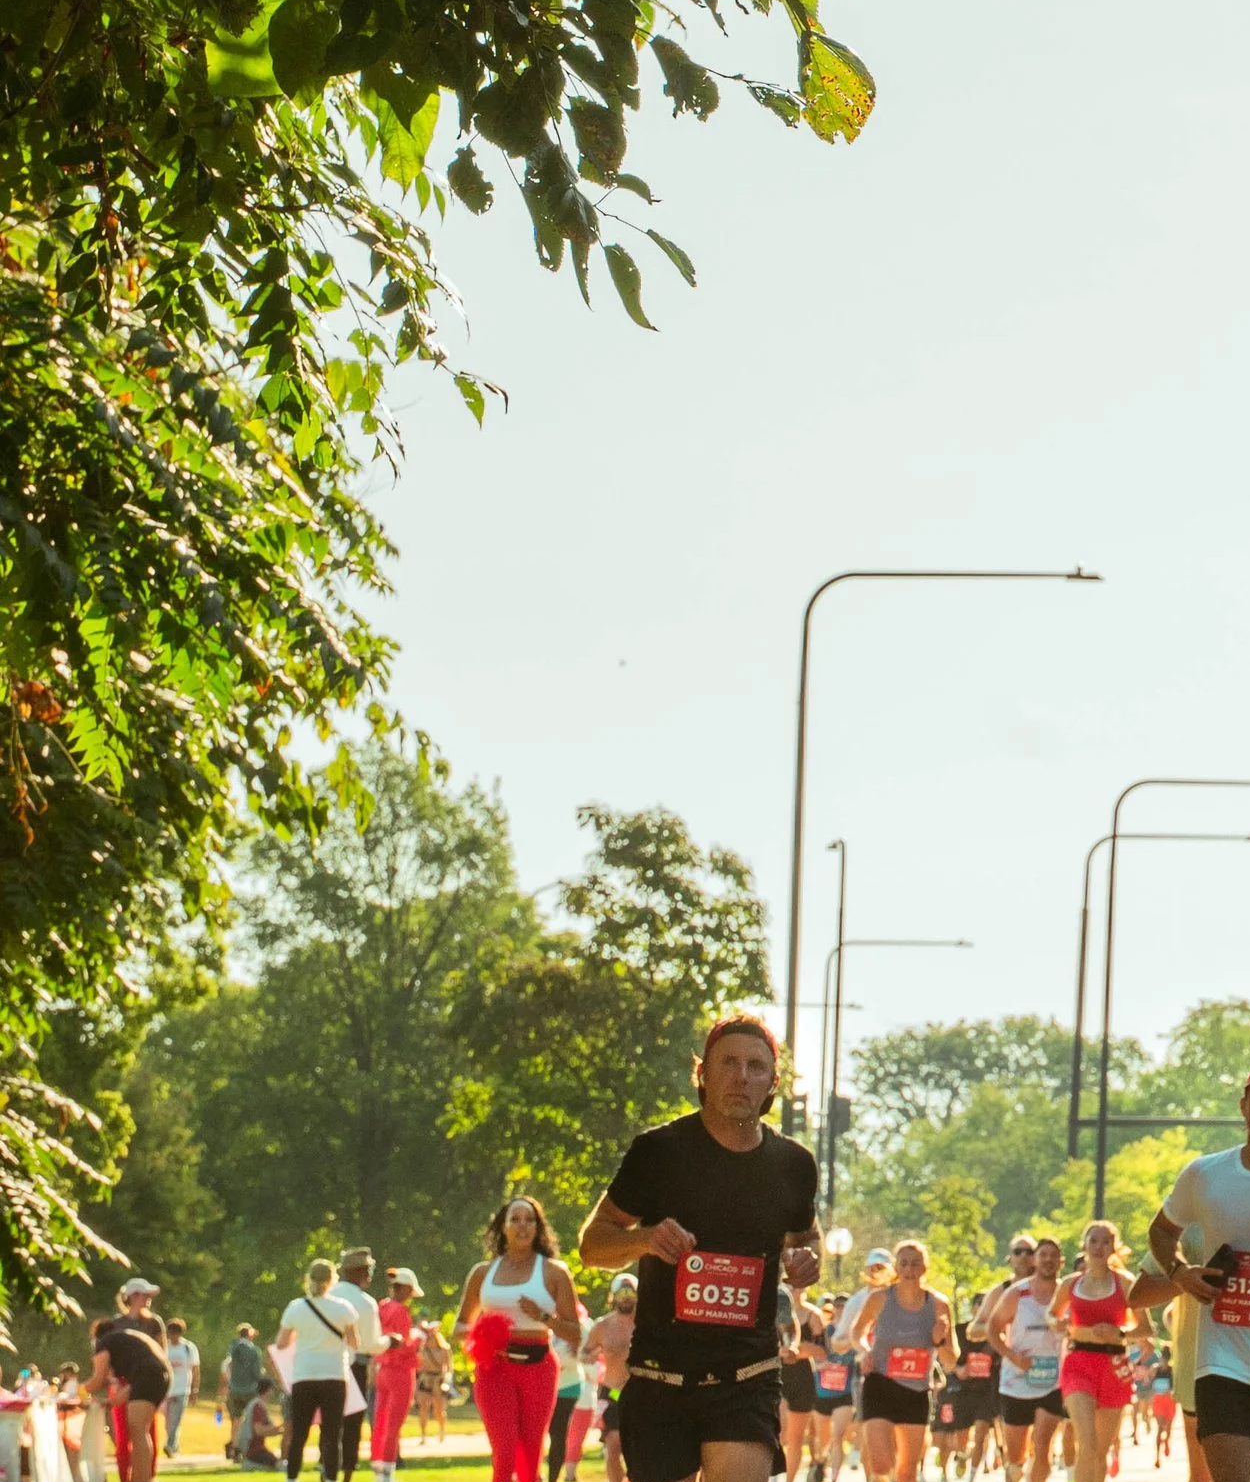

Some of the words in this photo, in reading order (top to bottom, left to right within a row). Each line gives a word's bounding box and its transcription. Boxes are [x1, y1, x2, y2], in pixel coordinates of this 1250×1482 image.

[704, 1263, 740, 1274] CHICAGO
[685, 1282, 750, 1307] 6035
[683, 1308, 704, 1317] HALF
[705, 1310, 750, 1321] MARATHON
